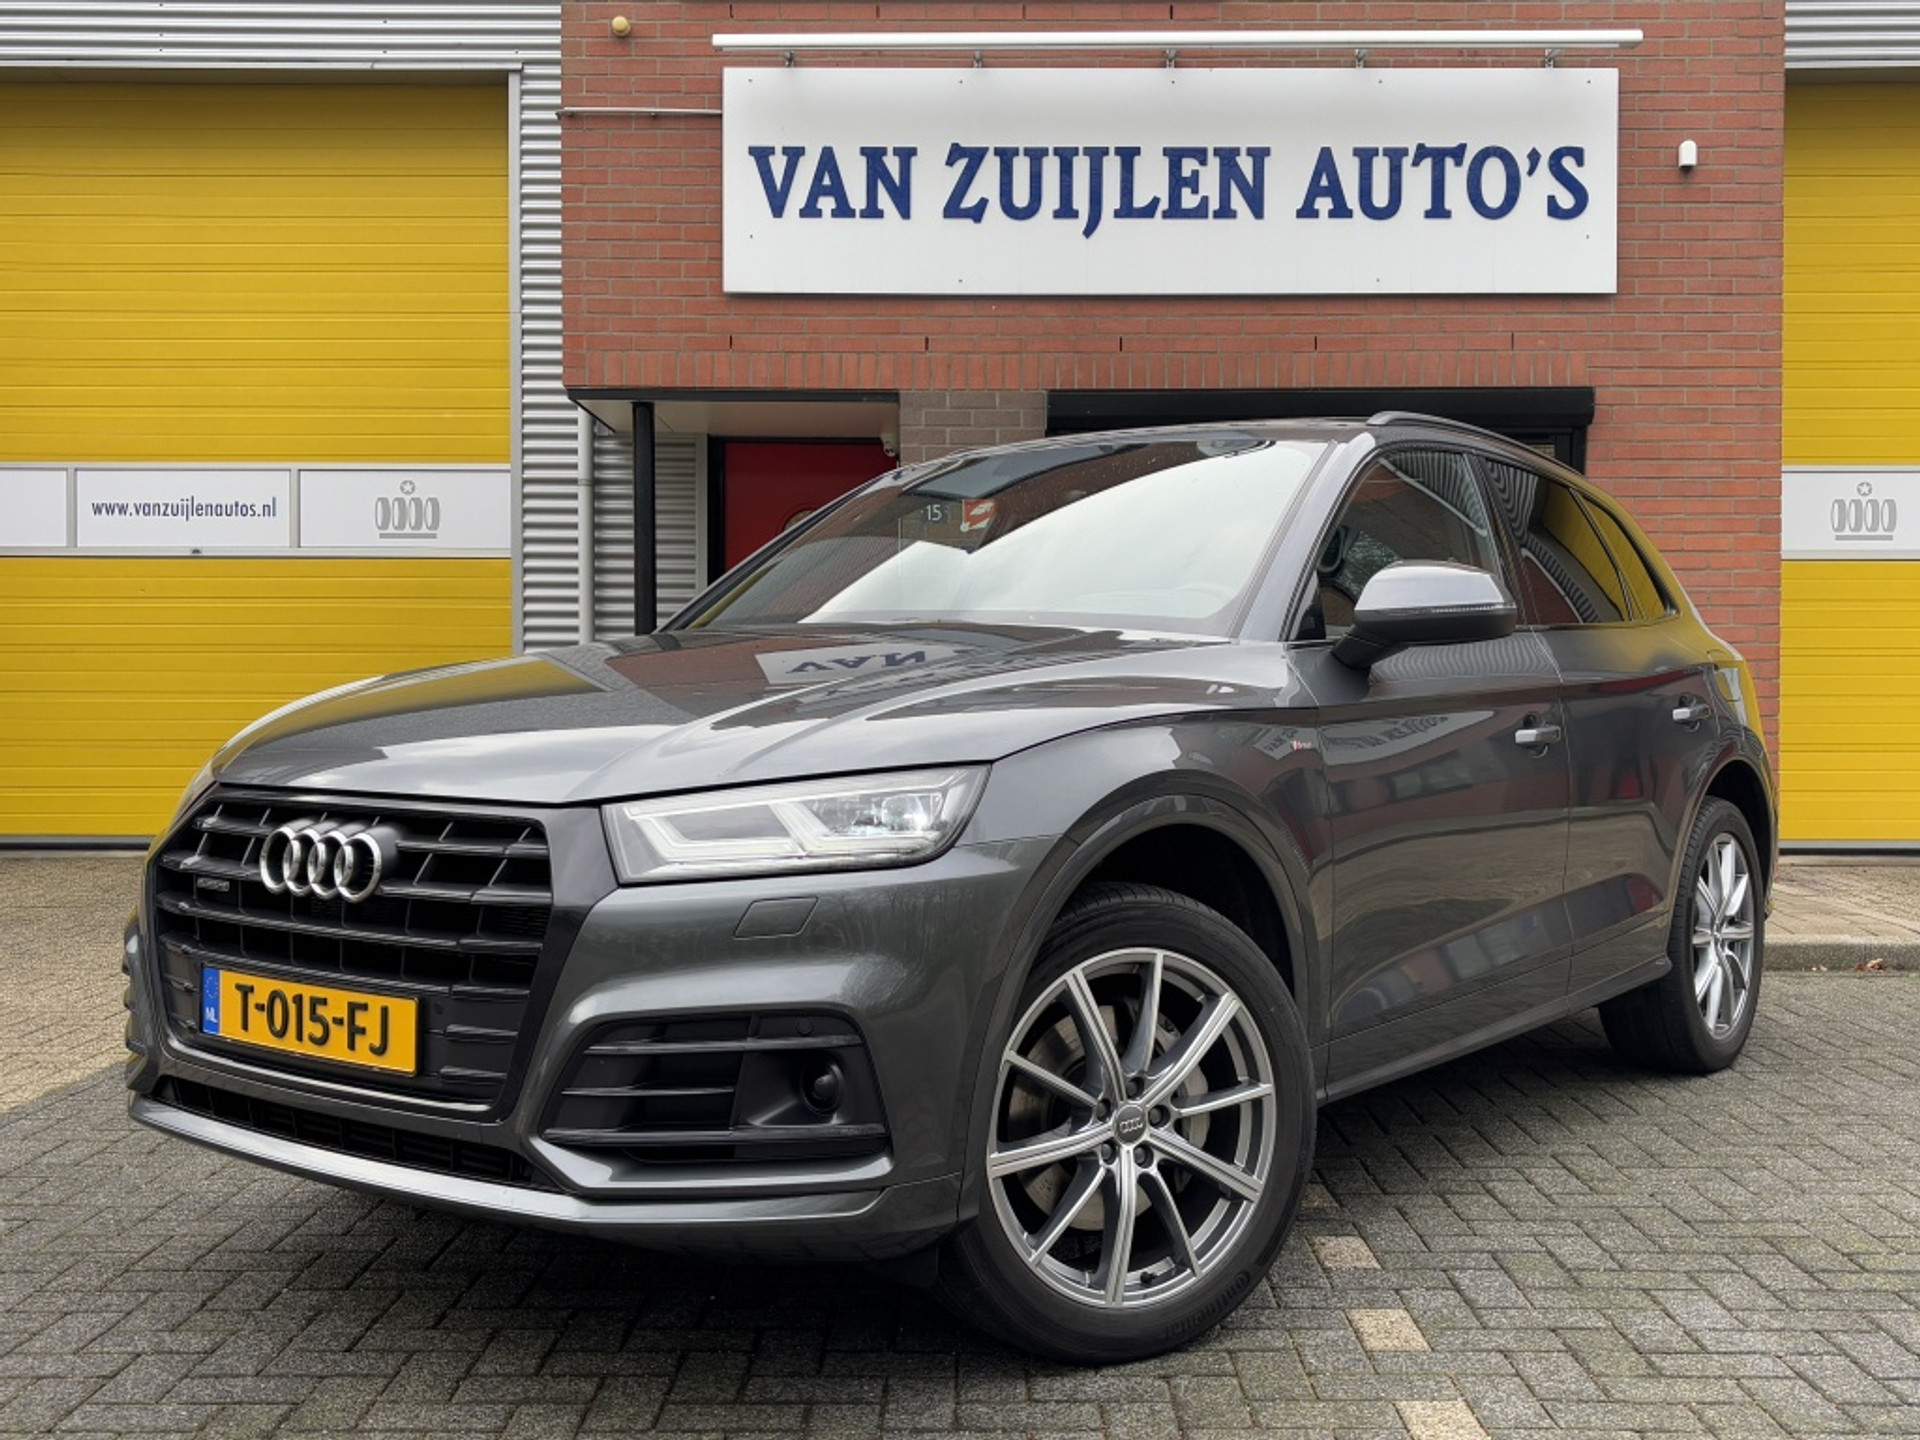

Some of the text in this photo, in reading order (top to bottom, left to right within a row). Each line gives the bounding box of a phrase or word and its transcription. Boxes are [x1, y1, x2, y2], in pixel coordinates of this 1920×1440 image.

[748, 143, 1589, 239] VAN ZUIJLEN AUTO'S
[91, 495, 277, 522] www.vanzuijlenautos.nl
[926, 504, 943, 521] 15
[205, 1006, 219, 1024] NL
[235, 983, 389, 1056] T-015-FJ
